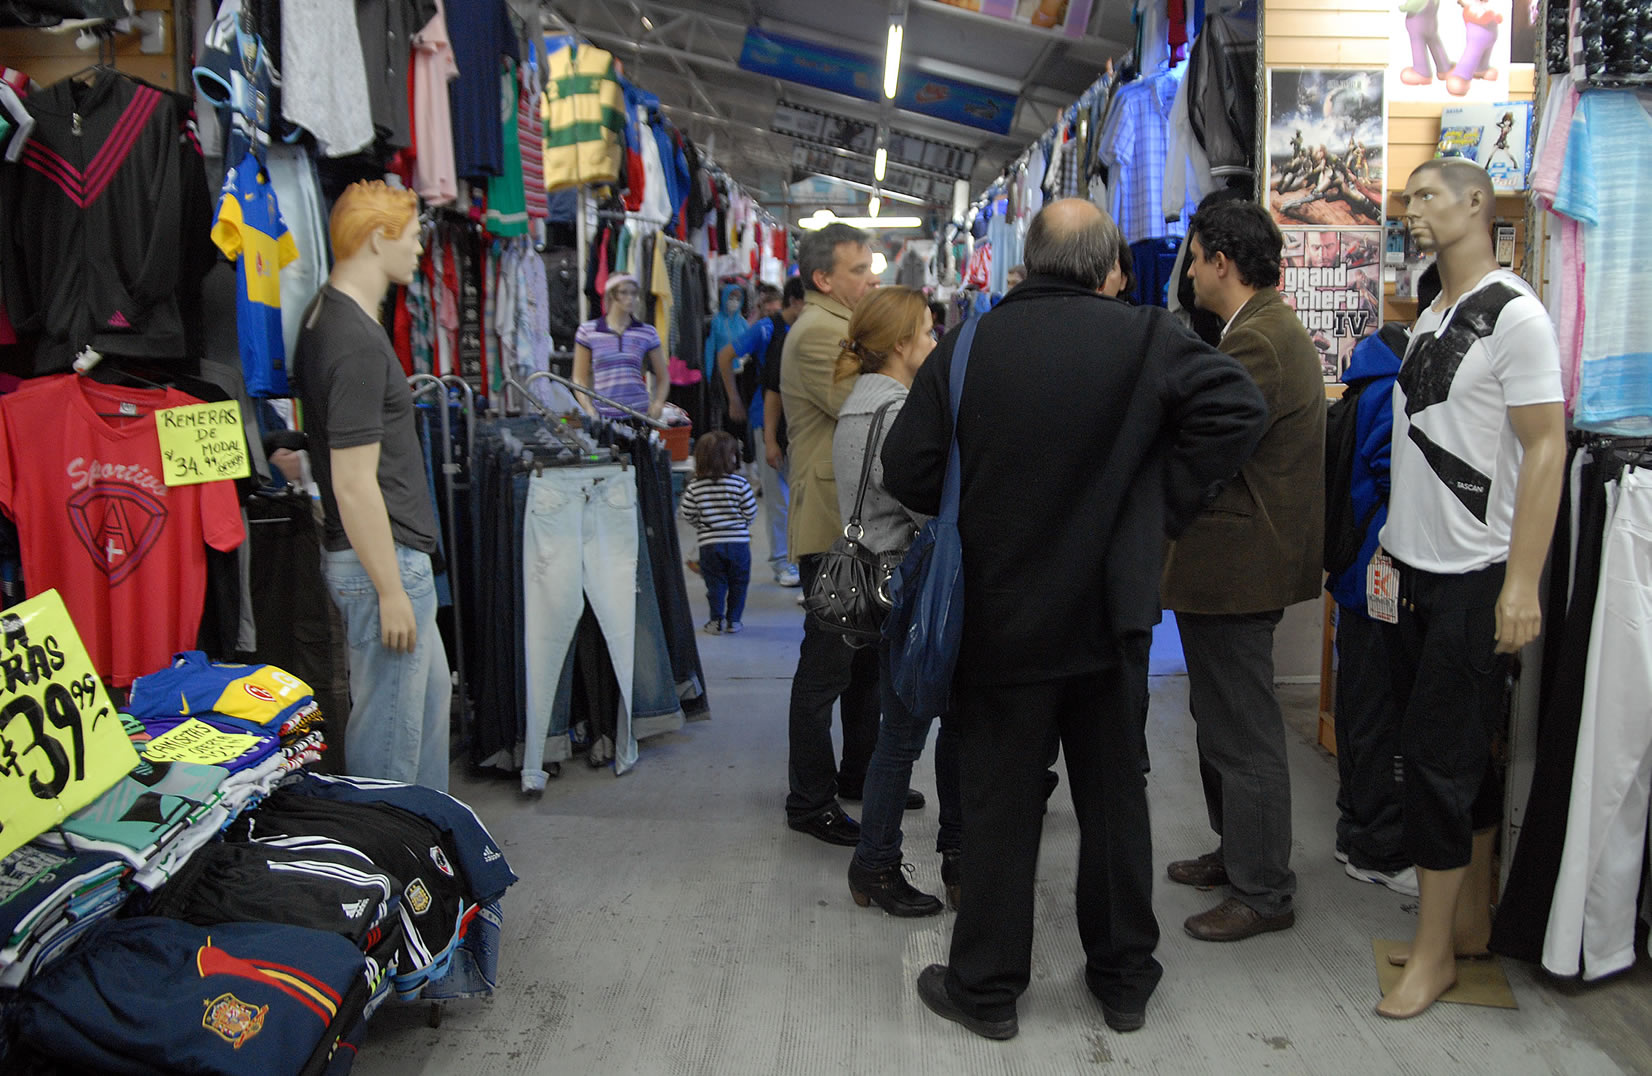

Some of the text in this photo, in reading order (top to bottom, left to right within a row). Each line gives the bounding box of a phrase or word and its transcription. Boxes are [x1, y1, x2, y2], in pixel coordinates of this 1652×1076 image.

[1284, 263, 1346, 292] grand
[1295, 289, 1359, 310] theft
[1296, 310, 1369, 337] uto IV
[161, 408, 237, 428] REMERAS
[195, 428, 217, 442] DE
[202, 440, 241, 456] MODAL
[0, 635, 65, 694] RAS
[145, 723, 212, 759] CAMISETAS
